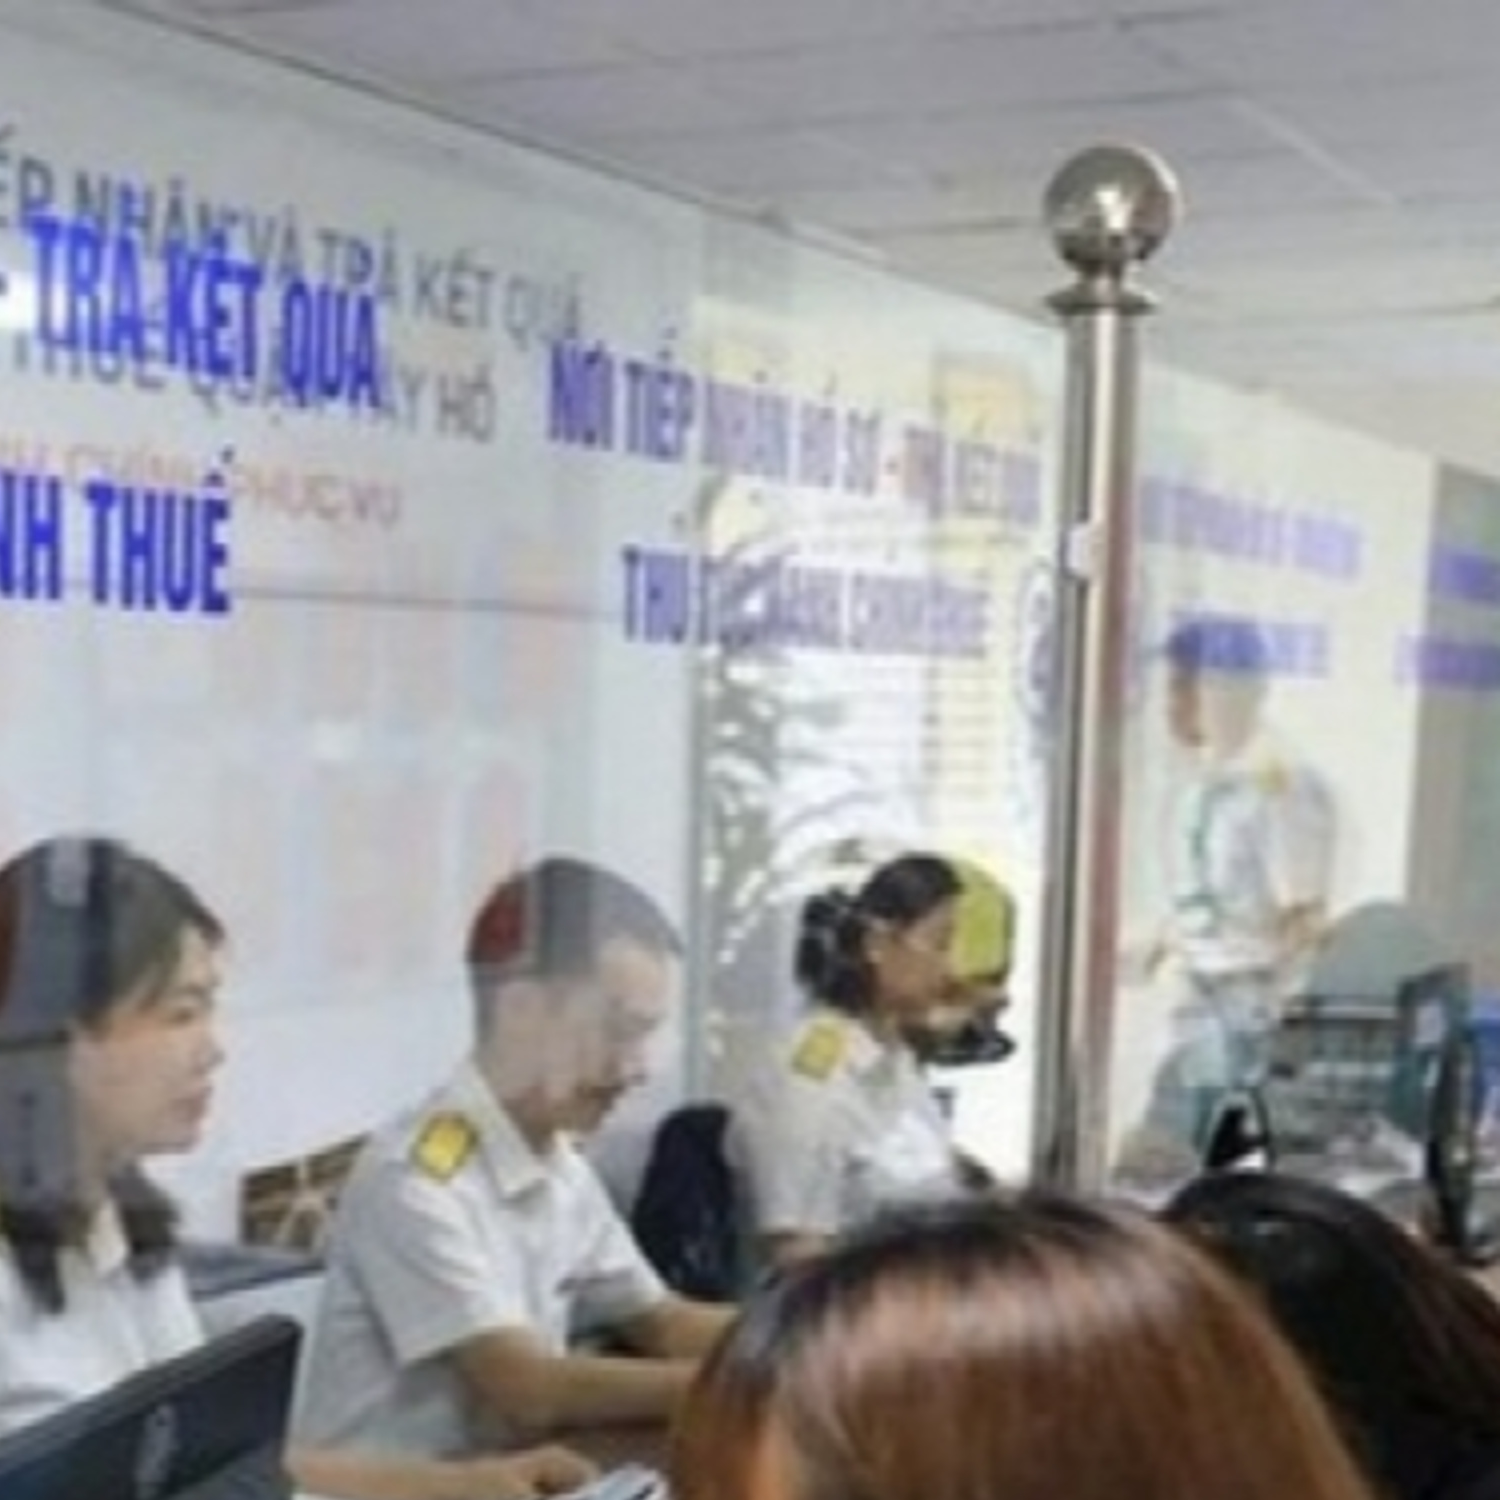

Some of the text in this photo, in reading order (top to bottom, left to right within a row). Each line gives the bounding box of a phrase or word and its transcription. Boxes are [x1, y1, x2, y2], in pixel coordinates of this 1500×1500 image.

[26, 180, 150, 370] TRẢ
[164, 203, 264, 380] KẾT
[83, 445, 234, 614] THUẾ
